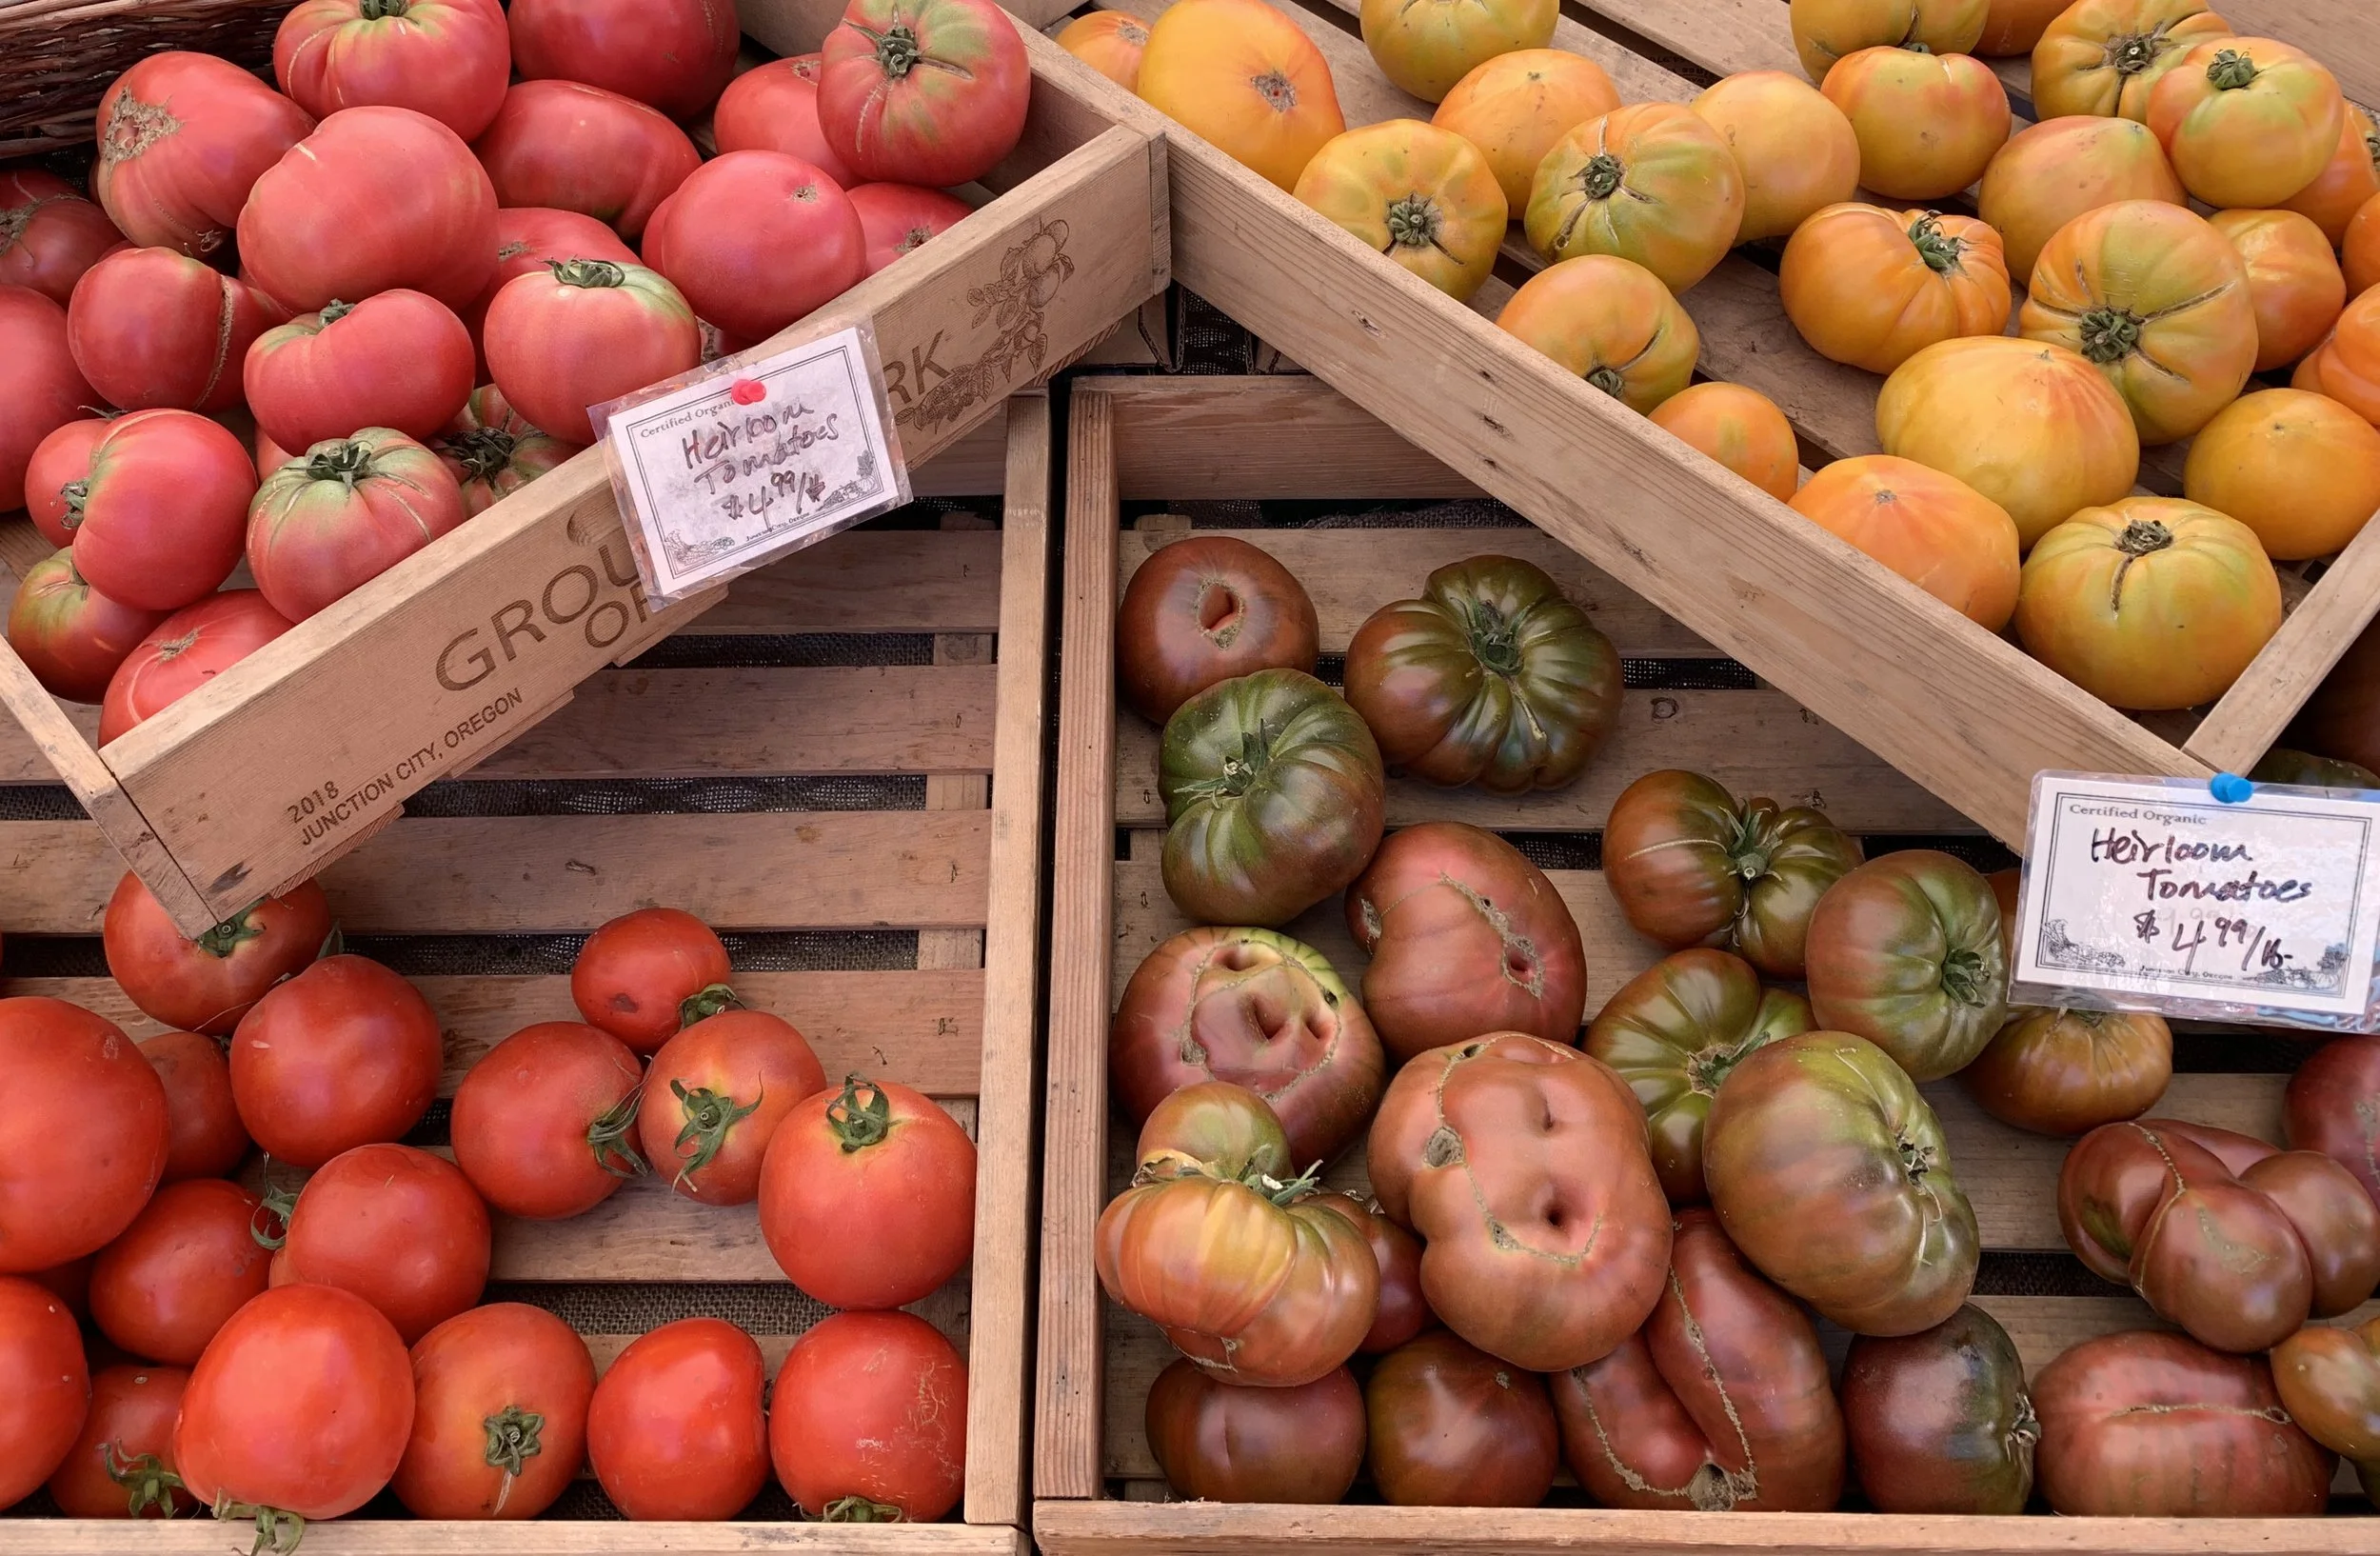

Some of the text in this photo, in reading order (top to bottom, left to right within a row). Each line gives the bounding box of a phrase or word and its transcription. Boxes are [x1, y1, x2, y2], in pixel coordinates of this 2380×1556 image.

[640, 398, 735, 439] Certified Organi
[681, 396, 815, 469] Heirloom
[694, 412, 840, 494] Tomatoes
[301, 687, 524, 846] JUNCTION CITY, OREGON
[288, 780, 340, 824] 2018
[2069, 804, 2207, 826] Certified Organic
[2091, 828, 2253, 863] Heirloom
[2136, 868, 2312, 904] Tomatoes
